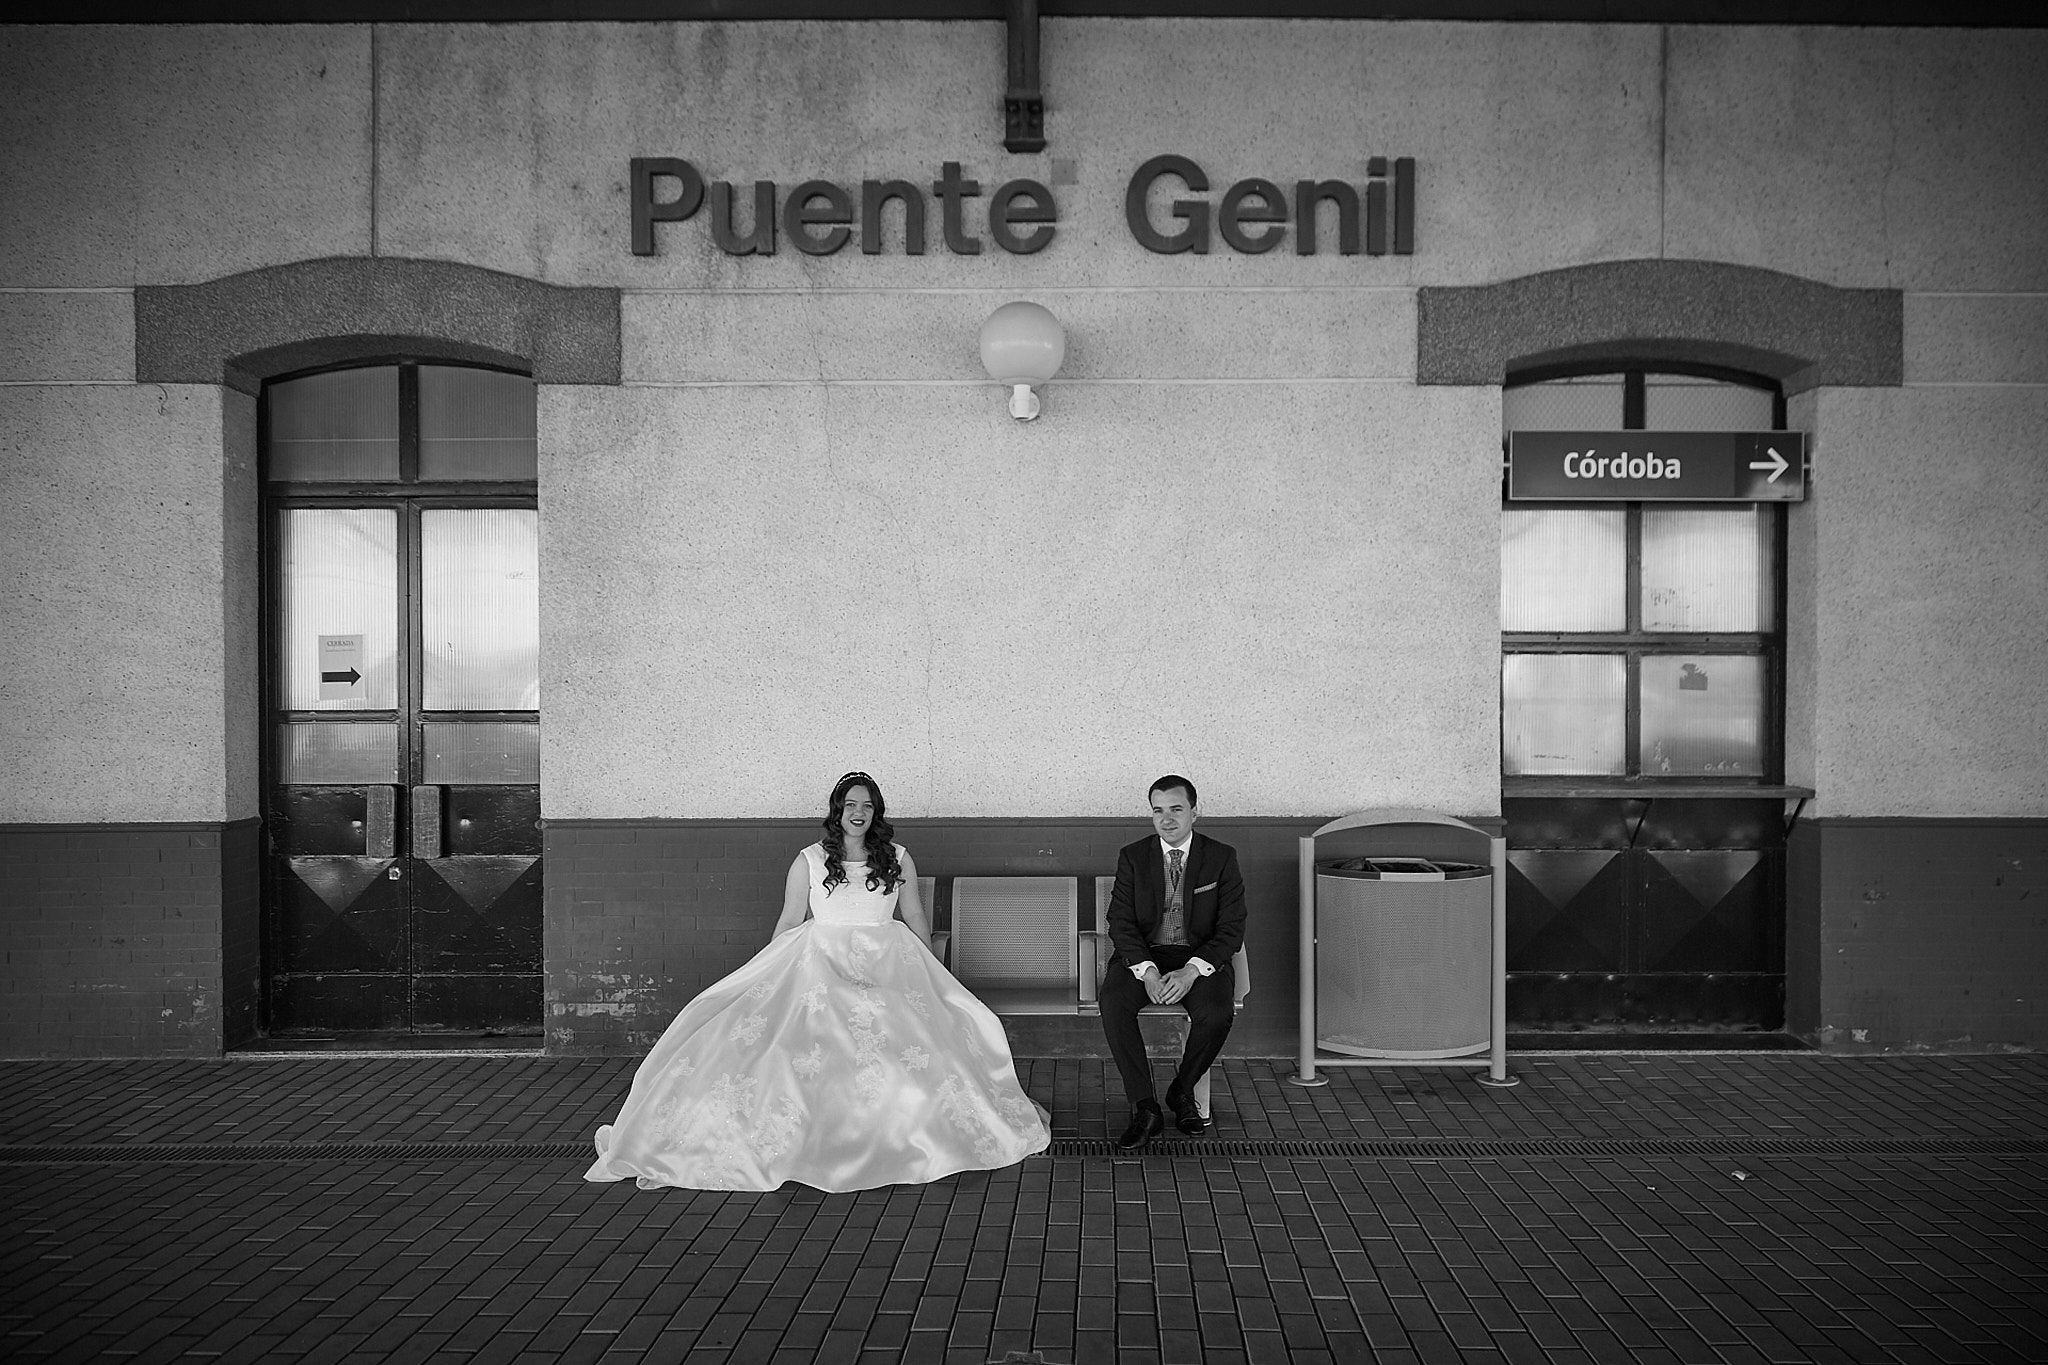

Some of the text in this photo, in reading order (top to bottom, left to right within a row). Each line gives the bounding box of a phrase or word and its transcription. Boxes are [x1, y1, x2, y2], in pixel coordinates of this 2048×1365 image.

[630, 154, 1415, 257] Puente Genil
[1563, 450, 1681, 479] Córdoba
